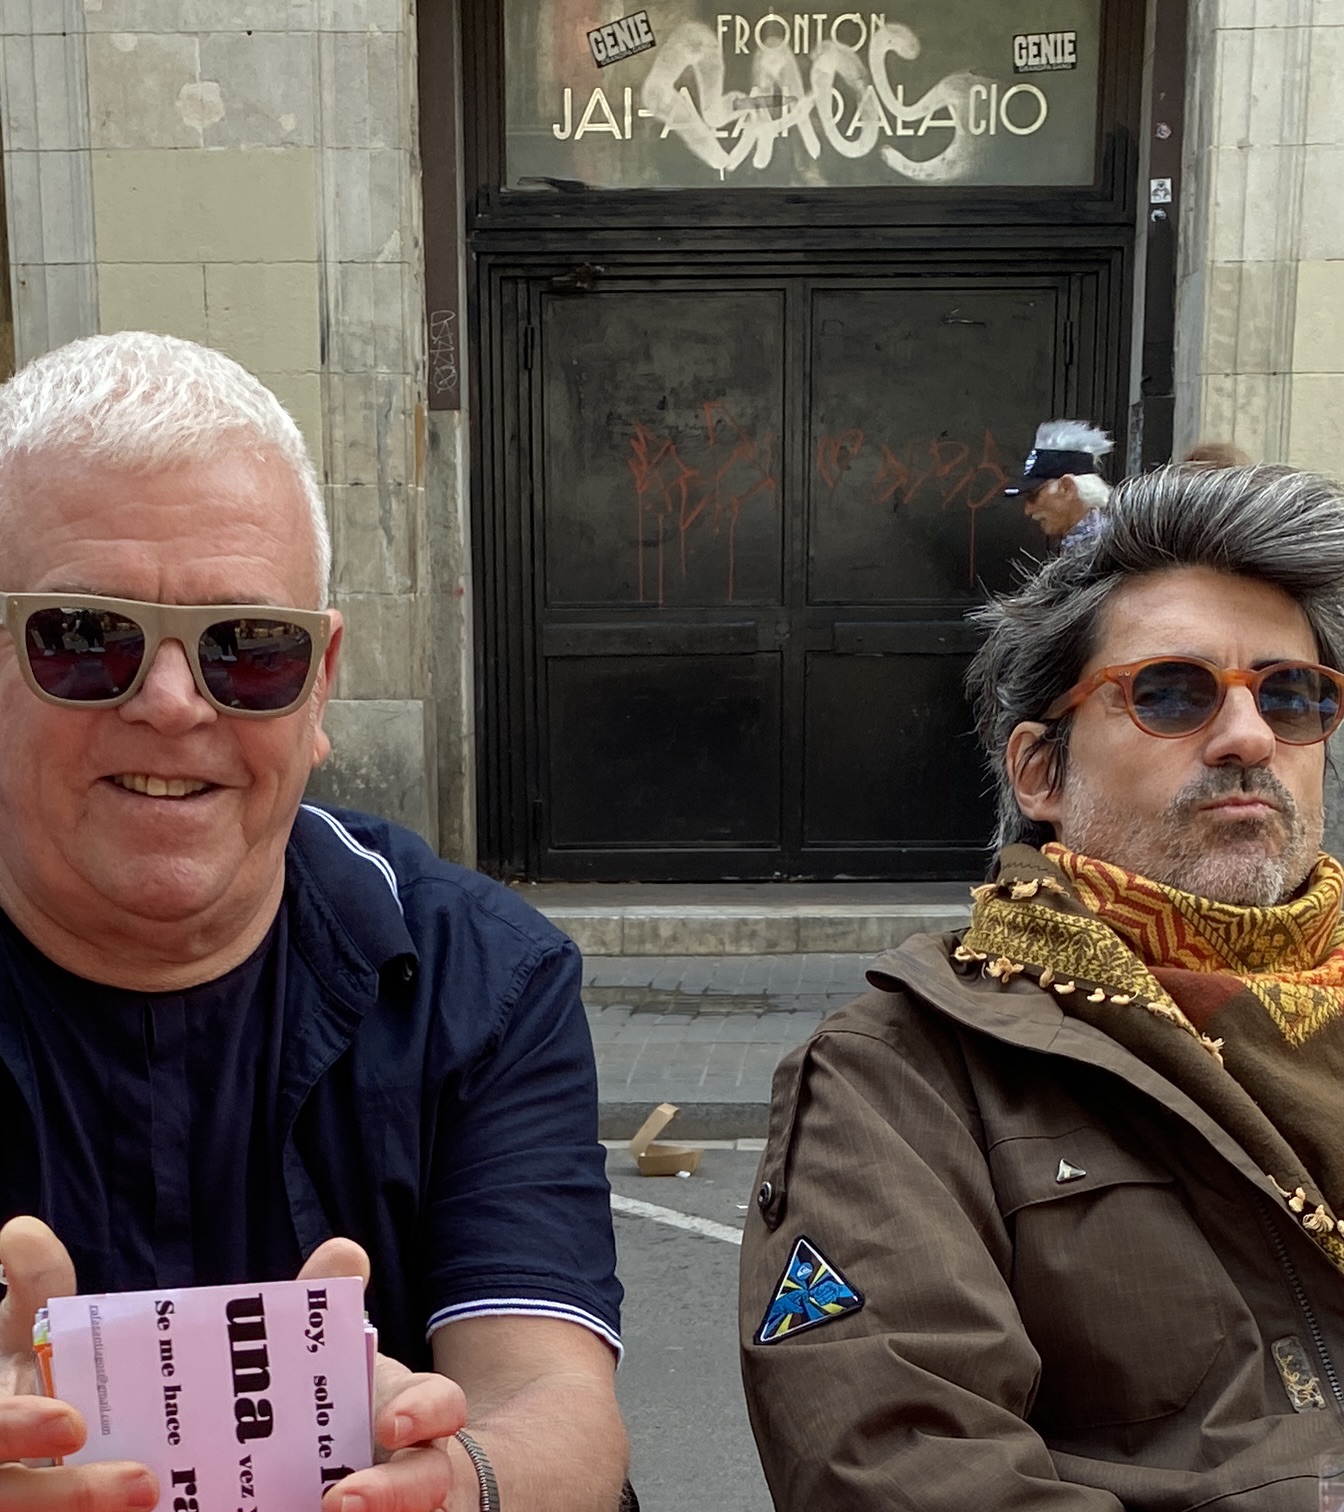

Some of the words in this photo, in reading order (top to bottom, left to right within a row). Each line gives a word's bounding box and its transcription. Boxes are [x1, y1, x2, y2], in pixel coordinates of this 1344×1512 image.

[589, 11, 653, 61] GENIE
[1014, 32, 1076, 67] GENIE
[154, 1300, 176, 1331] Se
[305, 1288, 328, 1354] Hoy,
[159, 1338, 176, 1377] me
[226, 1293, 273, 1444] una
[163, 1384, 183, 1446] hace
[312, 1374, 330, 1427] solo
[317, 1433, 336, 1459] te
[238, 1454, 255, 1499] vez
